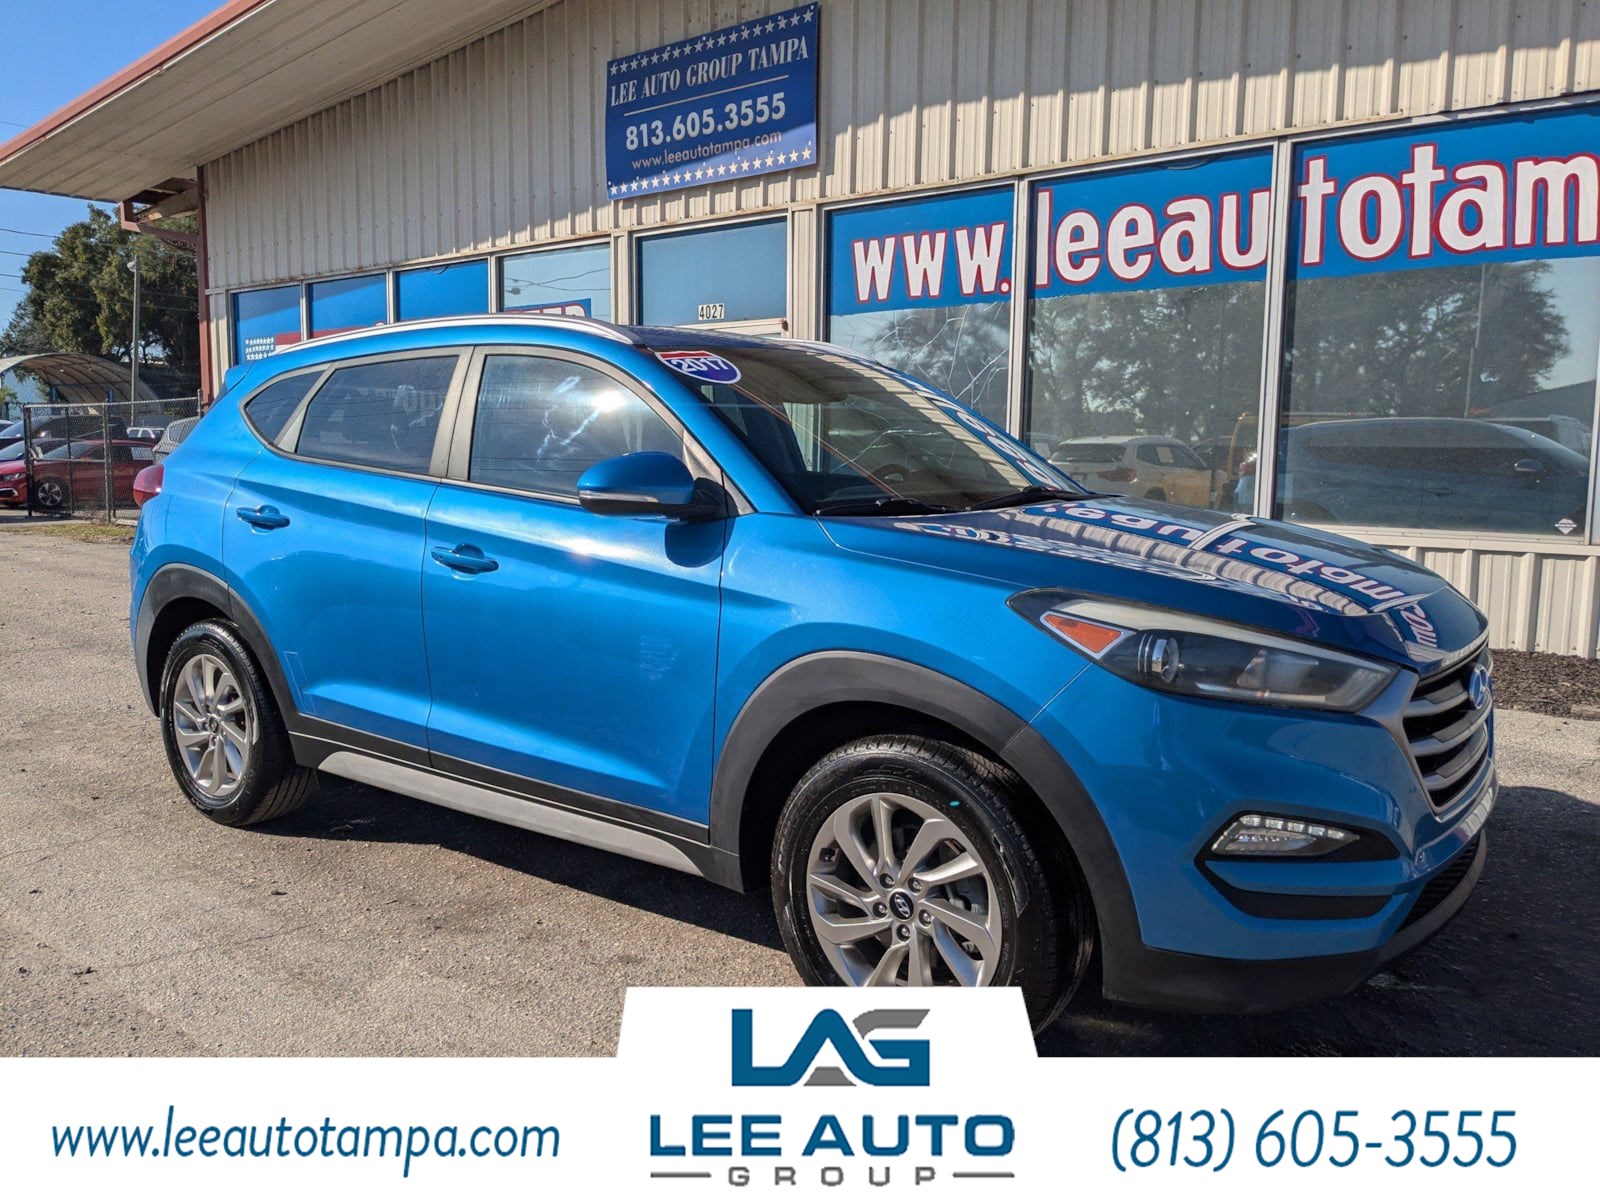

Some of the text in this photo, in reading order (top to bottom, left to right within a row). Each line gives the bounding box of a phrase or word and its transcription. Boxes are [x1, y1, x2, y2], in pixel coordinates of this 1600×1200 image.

[610, 35, 809, 107] LEE AUTO GROUP TAMPA
[625, 91, 786, 151] 813.605.3555
[631, 130, 783, 170] www.leeautotampa.com
[699, 304, 725, 320] 4027
[672, 356, 732, 374] 2017
